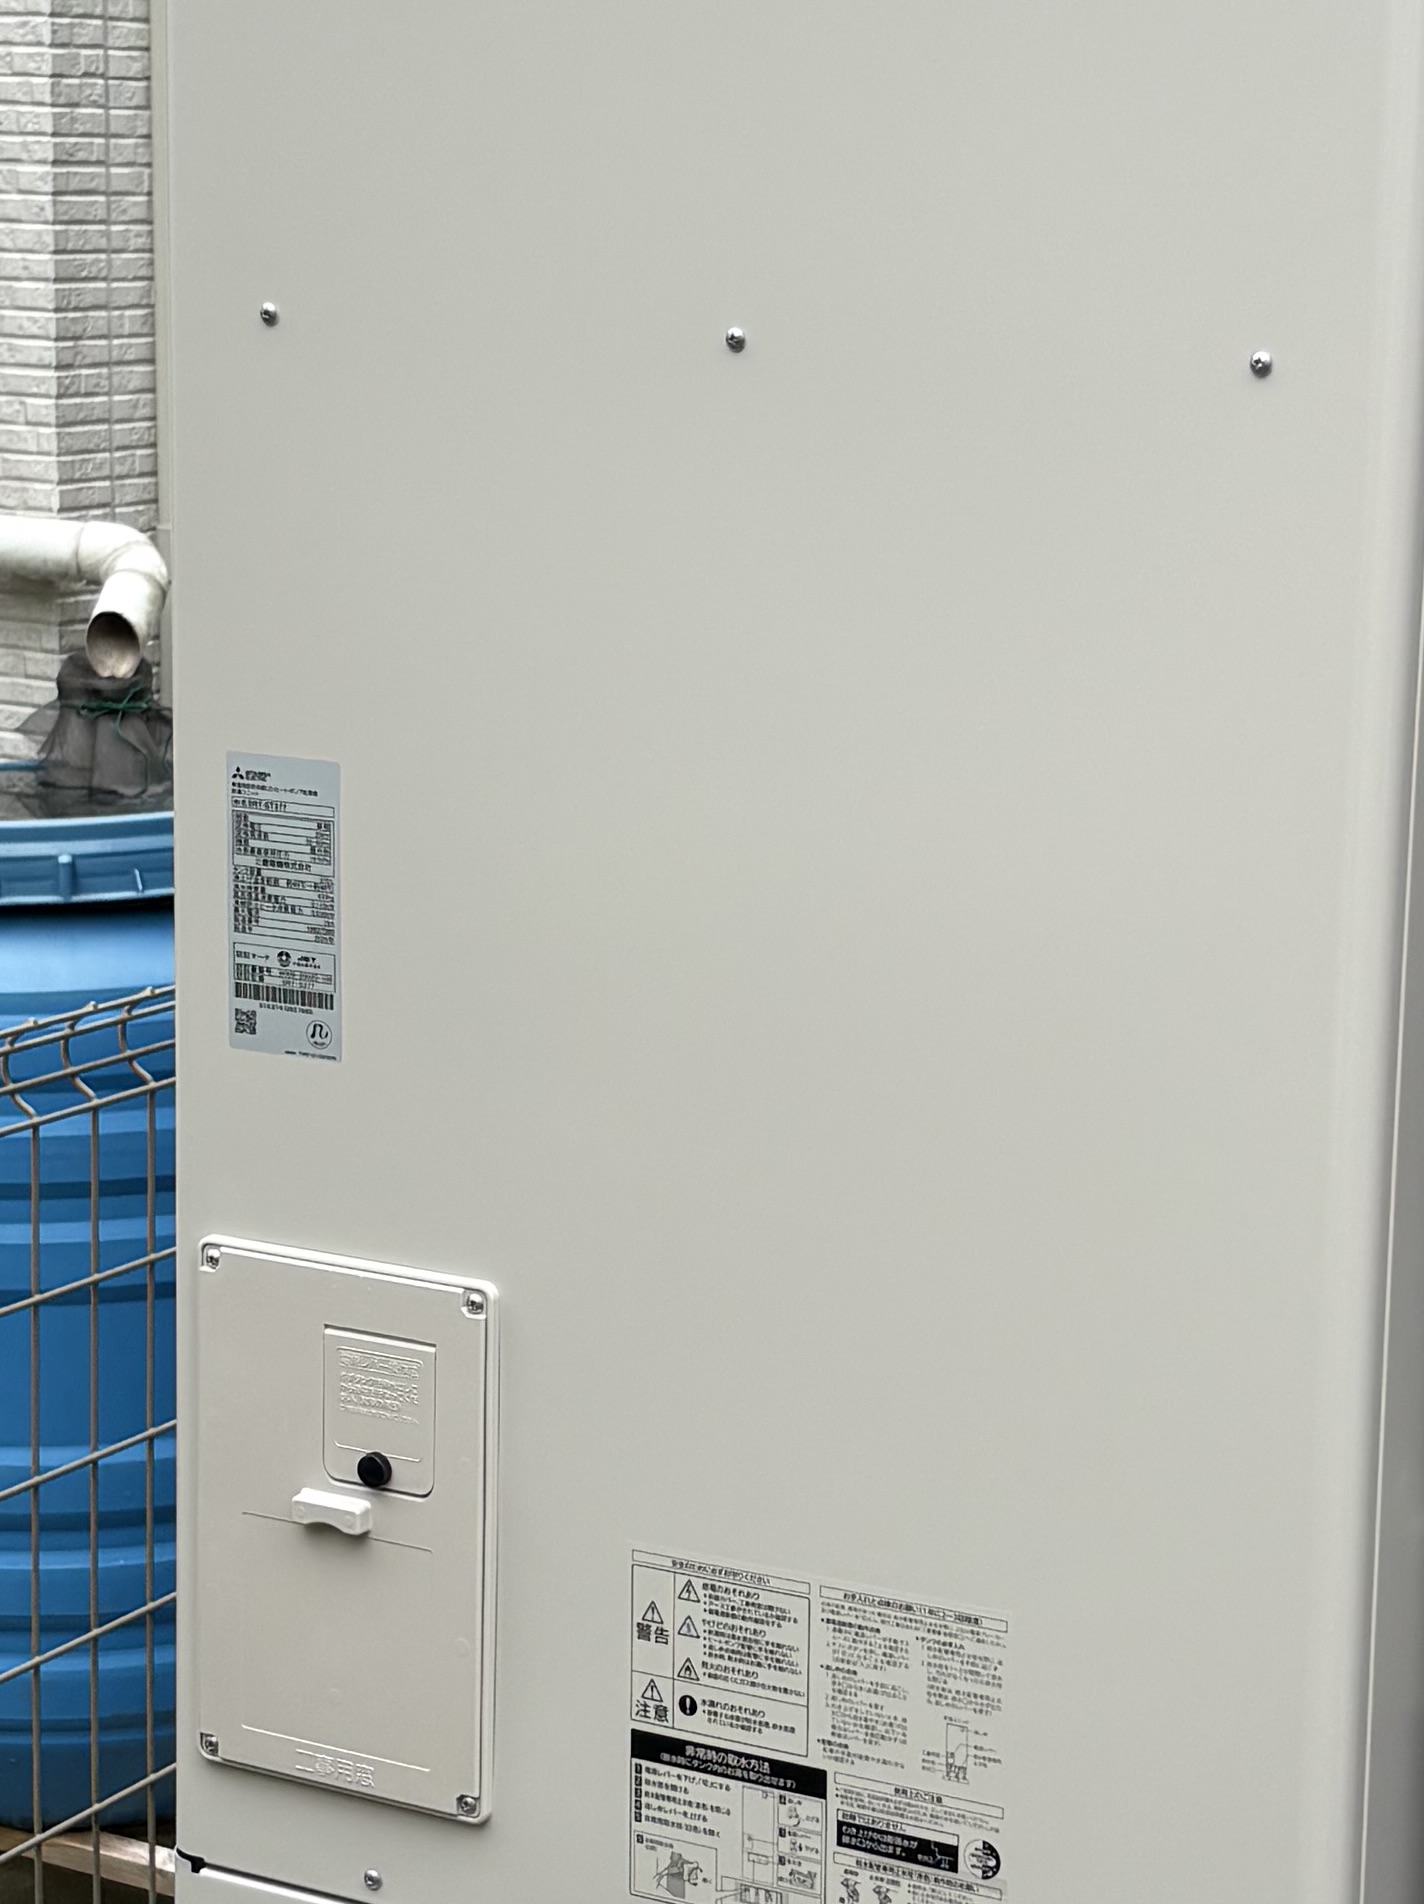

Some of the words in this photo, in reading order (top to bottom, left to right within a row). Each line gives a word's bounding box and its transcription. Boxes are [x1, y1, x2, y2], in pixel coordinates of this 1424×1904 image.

[636, 1622, 670, 1645] 警告
[635, 1699, 669, 1724] 注意
[685, 1745, 770, 1774] 非常時の取水方法
